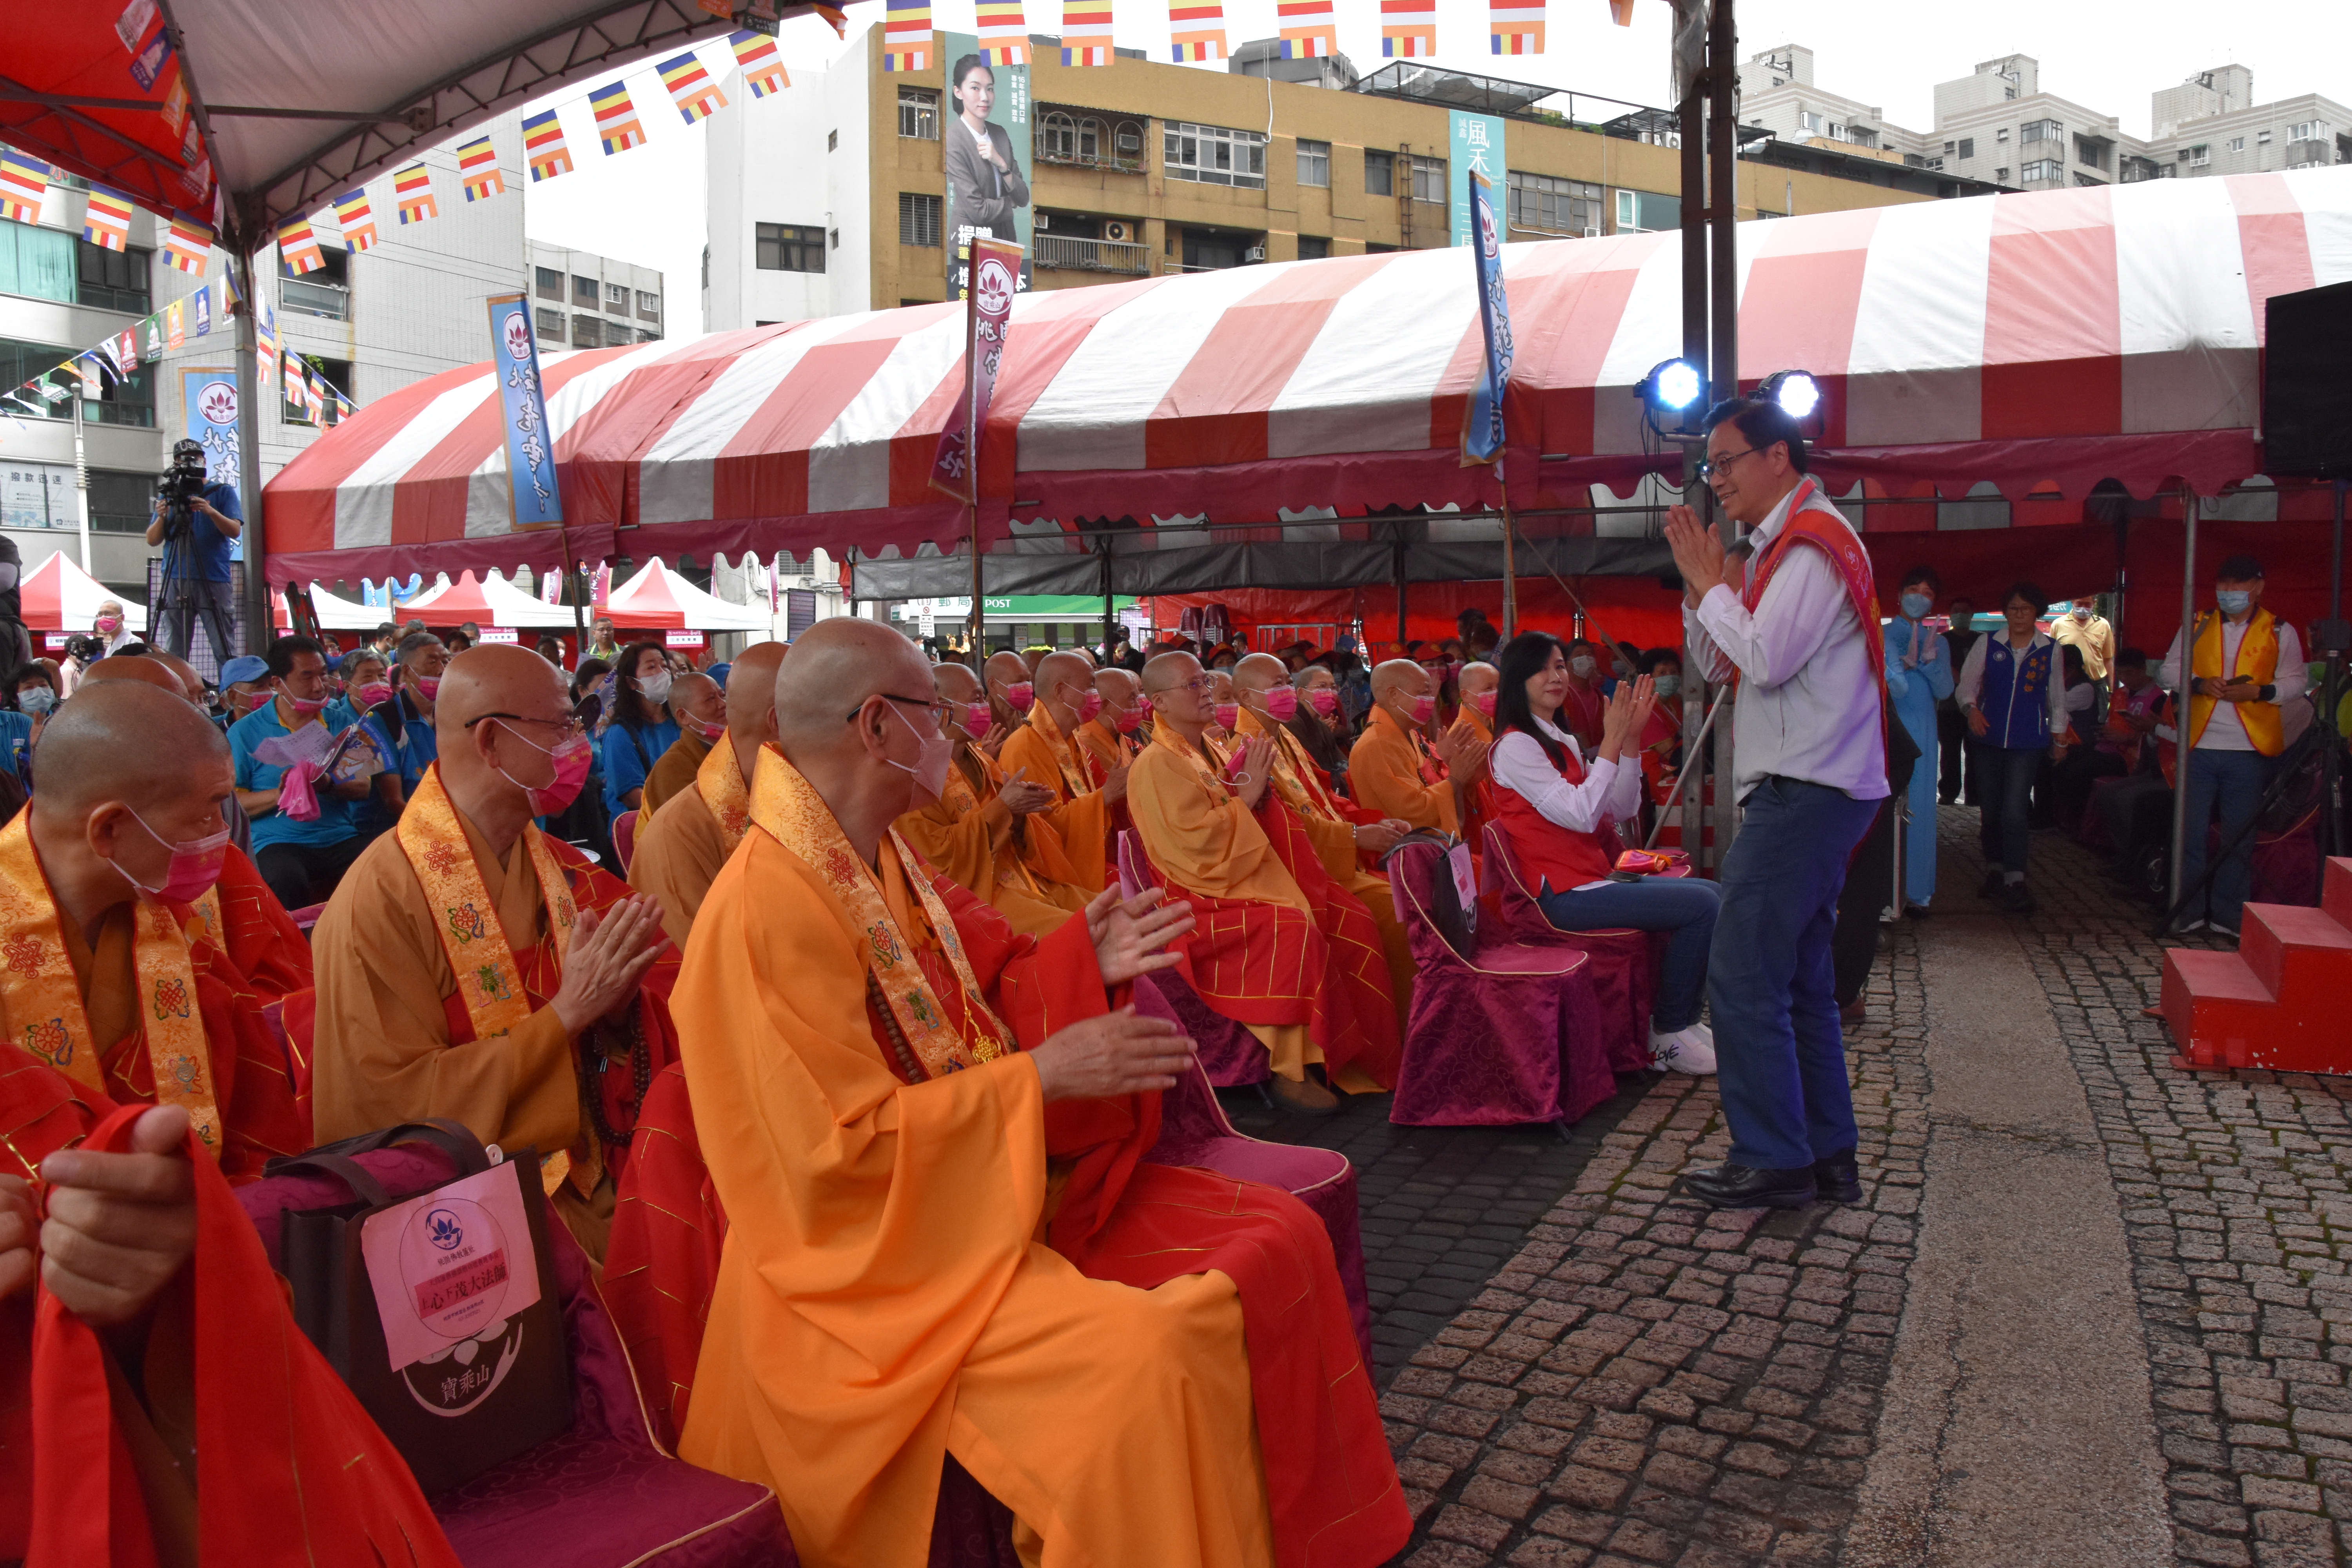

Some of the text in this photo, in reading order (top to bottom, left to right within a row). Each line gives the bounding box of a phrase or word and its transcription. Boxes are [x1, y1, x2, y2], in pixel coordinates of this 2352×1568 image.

[178, 441, 197, 451] USA
[938, 597, 970, 607] 郵局
[985, 599, 1011, 608] POST
[441, 1364, 490, 1406] 寶乘山
